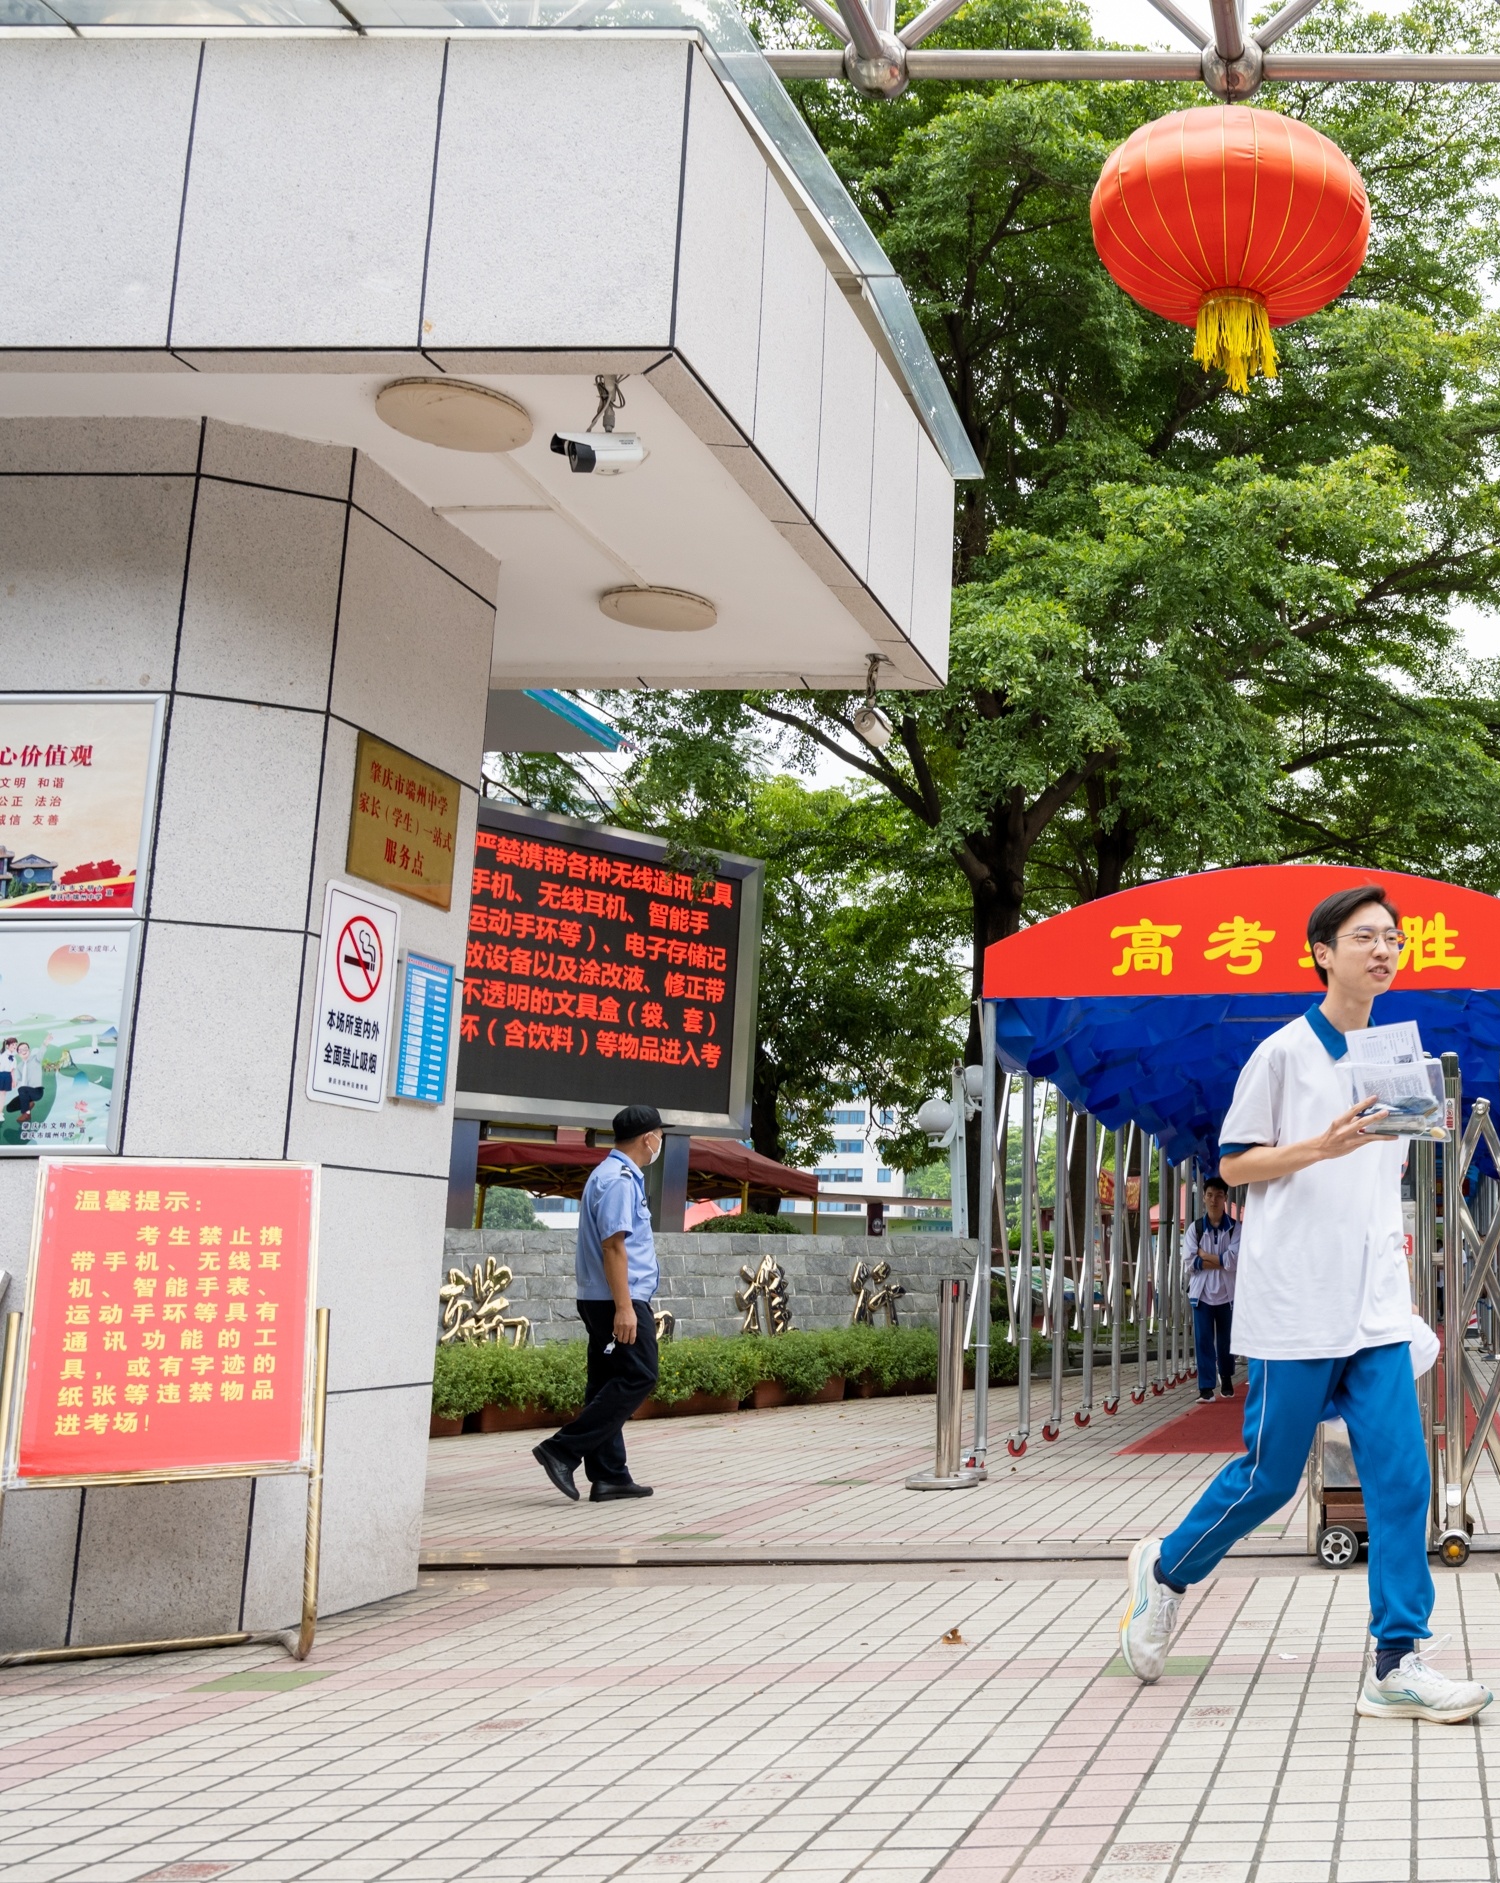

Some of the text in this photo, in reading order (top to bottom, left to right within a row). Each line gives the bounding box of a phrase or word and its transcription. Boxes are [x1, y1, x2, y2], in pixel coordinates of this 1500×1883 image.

[0, 744, 93, 768] 心价值观
[0, 777, 65, 789] 文明 和谐
[371, 760, 448, 816] 肇庆市端州中学
[35, 796, 62, 807] 法治
[33, 814, 59, 826] 友善
[358, 792, 452, 853] 家长（学生）一站式
[384, 837, 425, 878] 服务点
[471, 868, 709, 935] 手机、无线耳机、智能手
[468, 904, 727, 973] 运动手环等）、电子存储记
[1110, 912, 1467, 977] 高考胜
[465, 939, 726, 1004] 放设备以及涂改液、修正带
[463, 977, 718, 1037] 不透明的文具盒（袋、套）
[327, 1009, 380, 1042] 本场所室内外
[323, 1042, 378, 1074] 全面禁止吸烟
[74, 1189, 202, 1213] 温馨提示：
[136, 1225, 283, 1246] 考生禁止携
[70, 1251, 281, 1273] 带手机、无线耳
[68, 1276, 267, 1299] 机、智能手表、
[65, 1302, 279, 1325] 运动手环等具有
[62, 1328, 277, 1353] 通讯功能的工
[59, 1353, 276, 1381] 具，或有字迹的
[57, 1380, 274, 1408] 纸张等违禁物品
